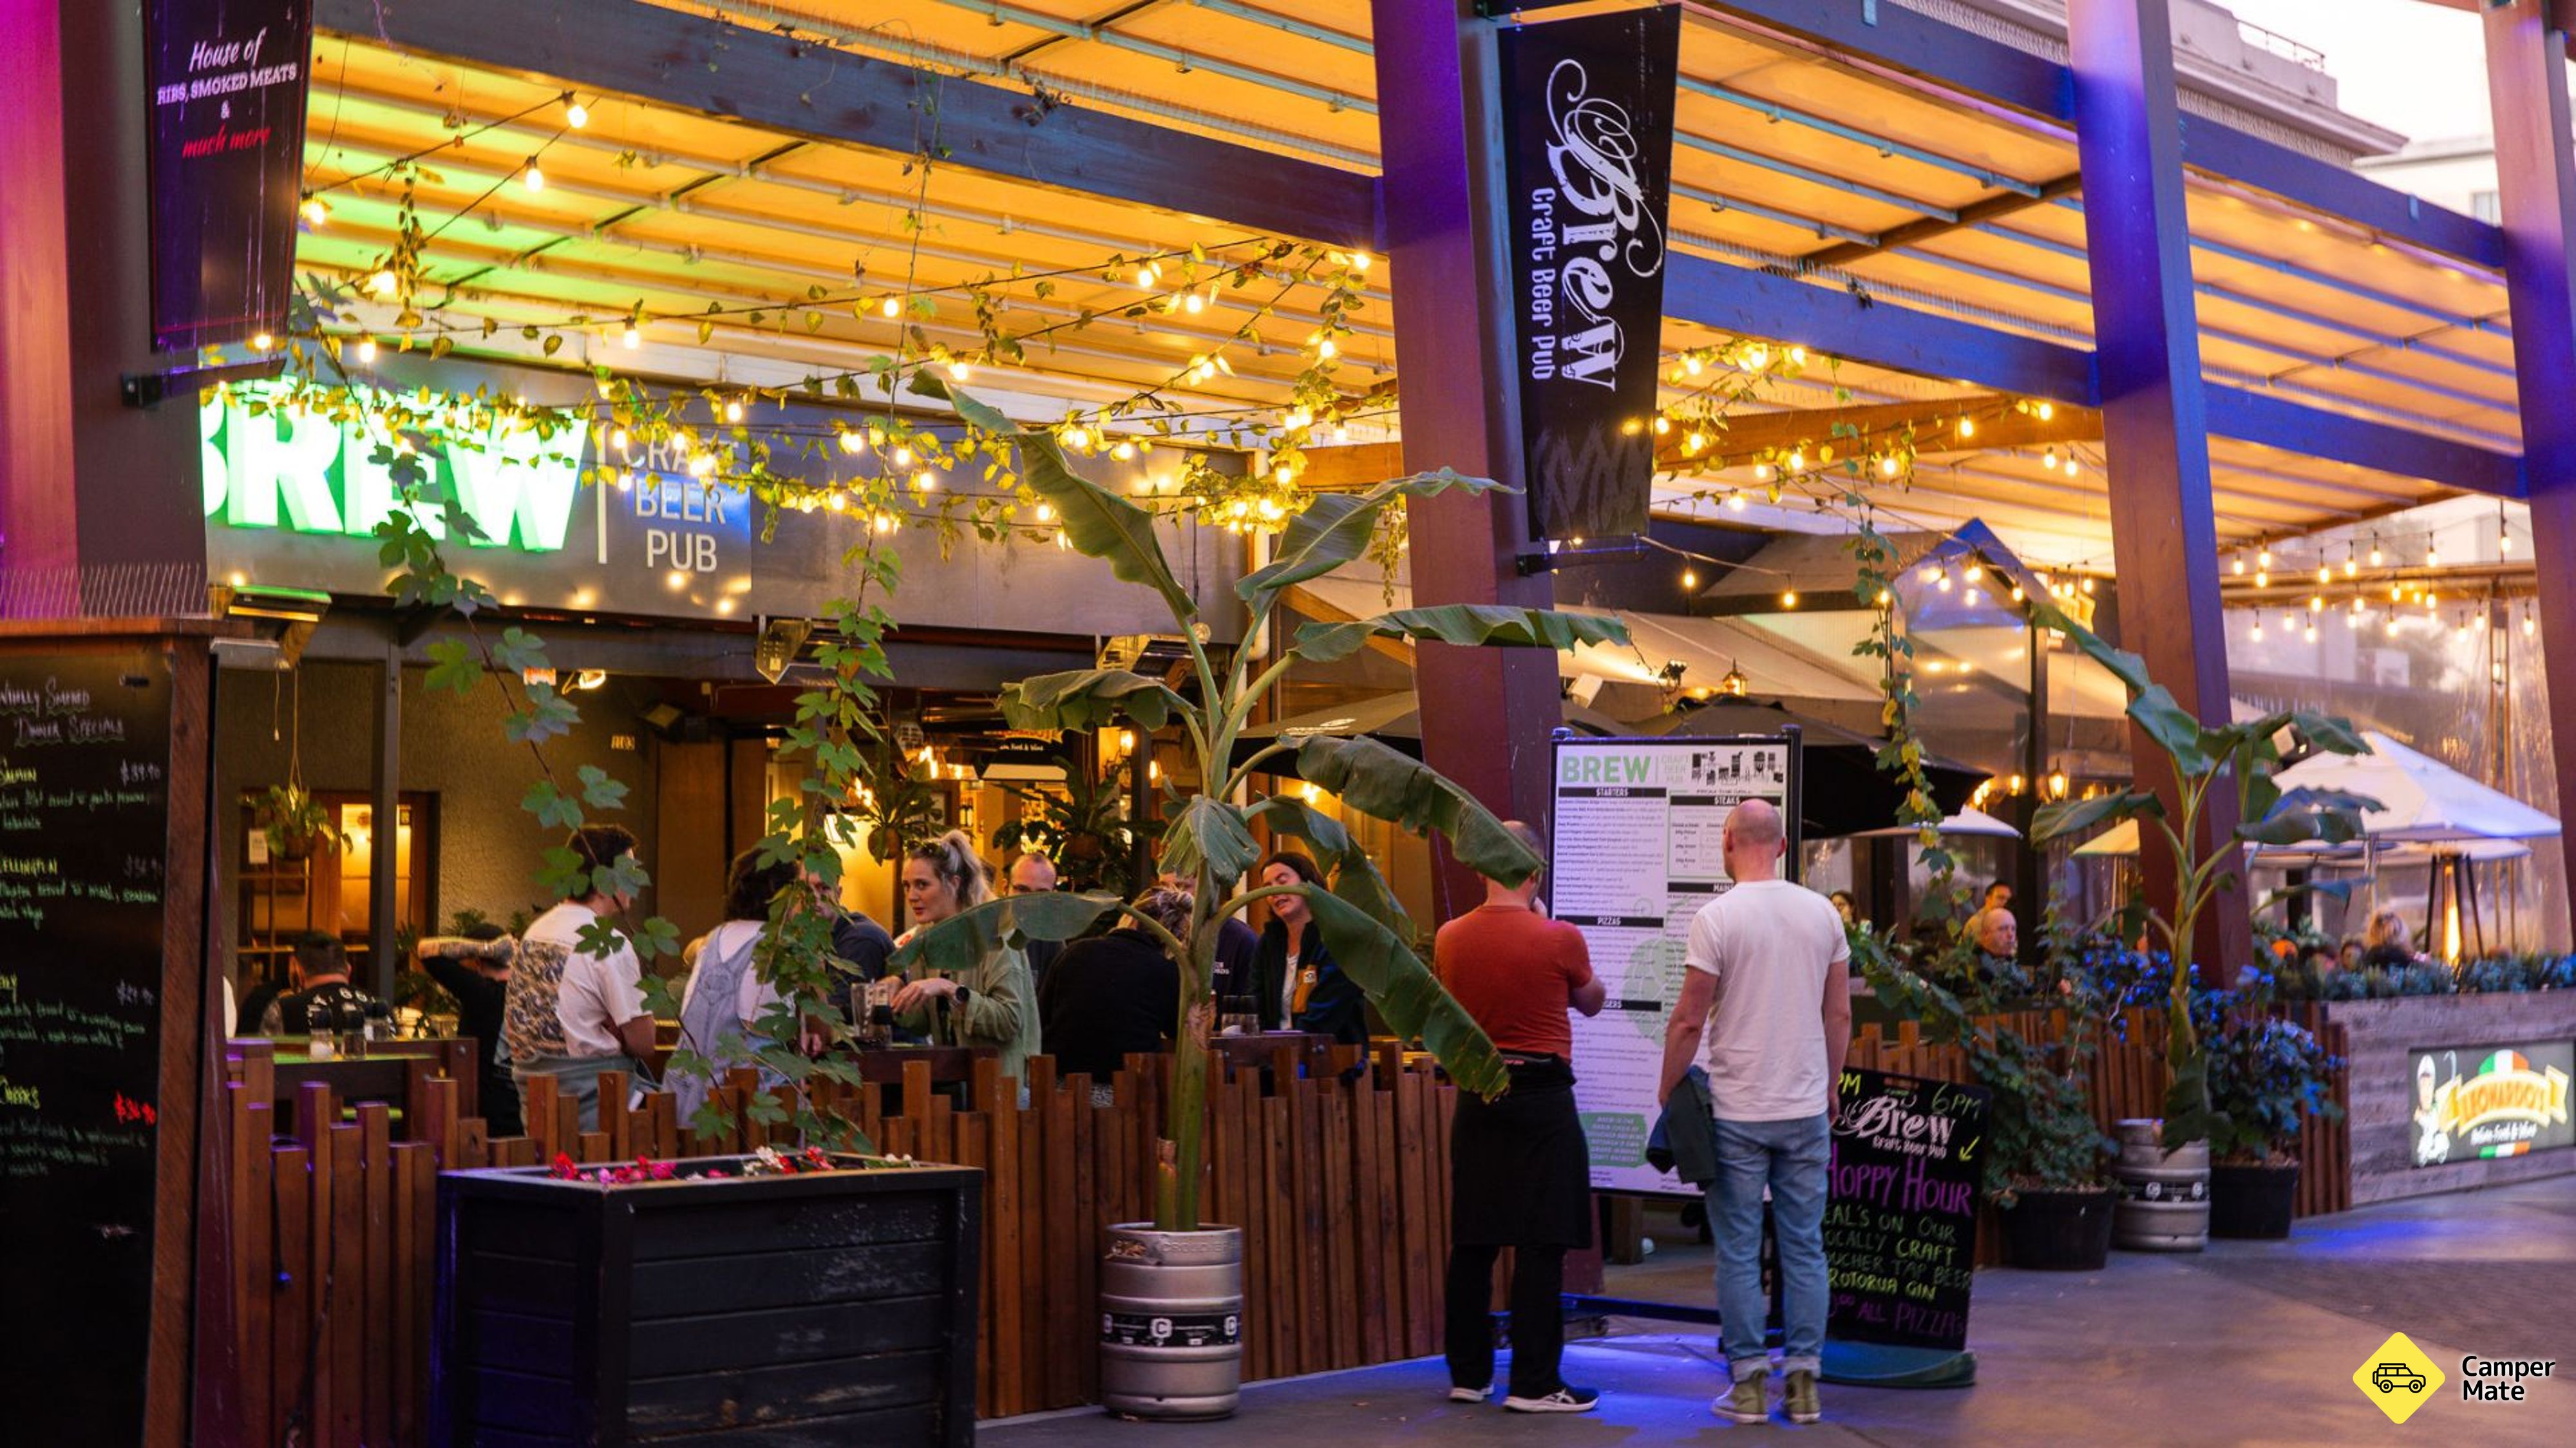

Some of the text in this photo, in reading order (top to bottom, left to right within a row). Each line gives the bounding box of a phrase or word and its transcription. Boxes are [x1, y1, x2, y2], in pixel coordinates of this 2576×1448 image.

[189, 27, 267, 72] House of
[157, 63, 298, 106] RIBS, SMOKED MEATS
[220, 100, 231, 119] &
[182, 124, 271, 158] much more
[1547, 59, 1663, 392] Brew
[636, 479, 726, 524] BEER
[647, 529, 717, 572] PUB
[1562, 755, 1651, 783] BREW
[1596, 787, 1629, 797] STARTERS
[1597, 916, 1621, 926] PIZZAS
[1830, 1095, 1956, 1145] Brew
[1902, 1154, 1972, 1217] HOUR
[1878, 1213, 1904, 1233] ON
[1895, 1238, 1958, 1266] CRAFT
[1904, 1279, 1936, 1300] GIN
